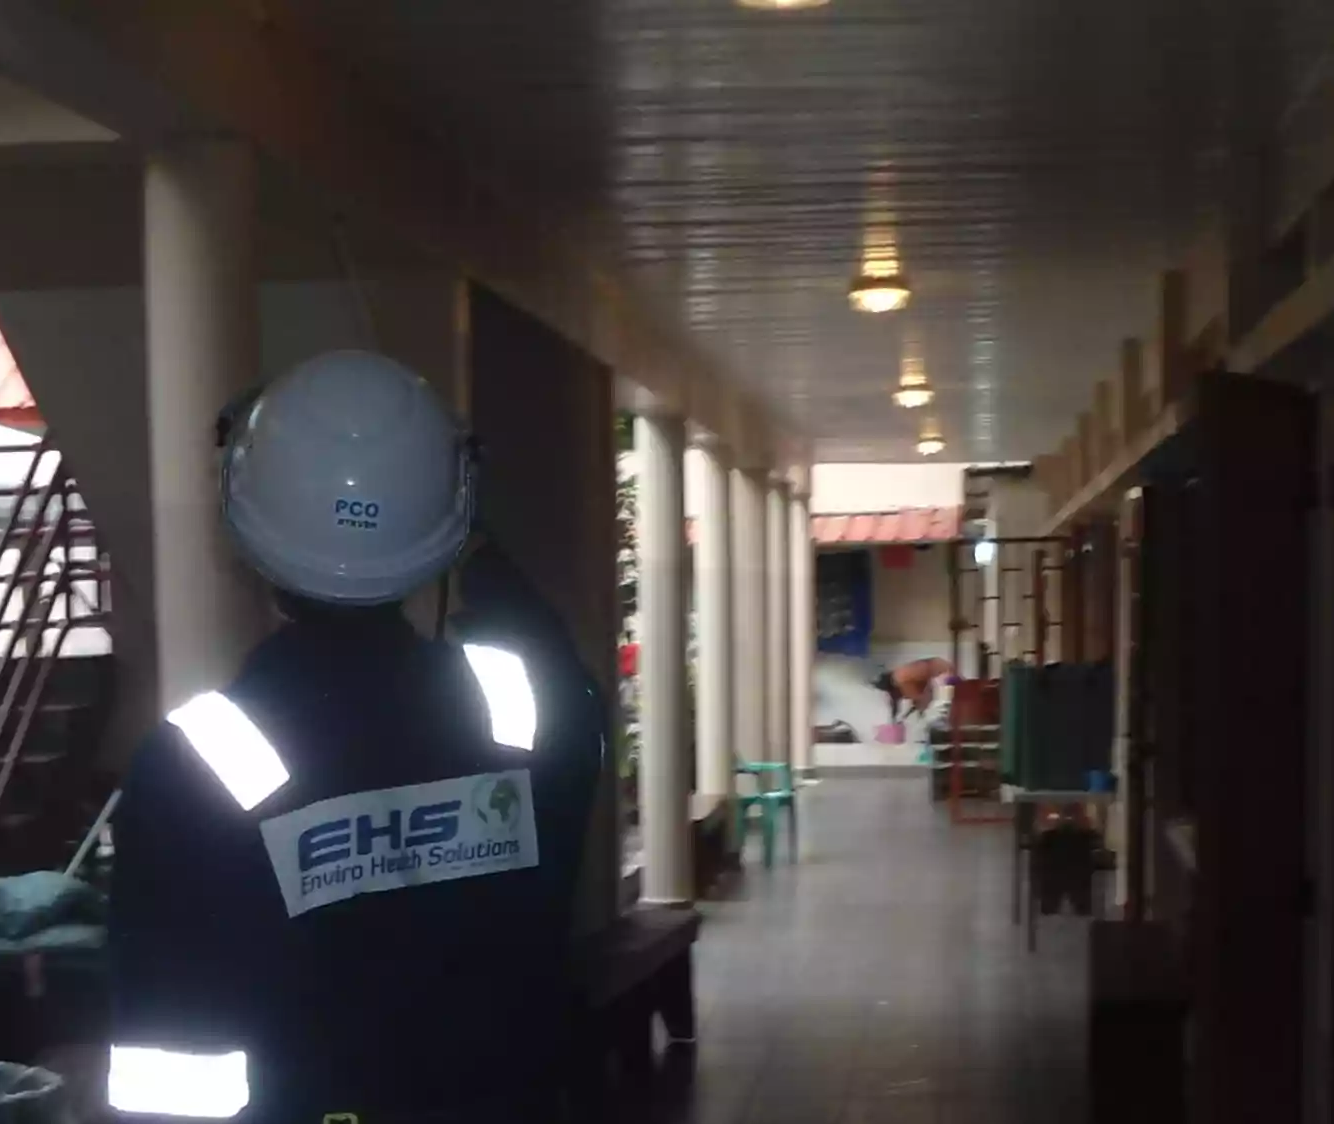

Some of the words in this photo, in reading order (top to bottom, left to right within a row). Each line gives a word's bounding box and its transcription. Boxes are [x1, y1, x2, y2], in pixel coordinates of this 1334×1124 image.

[335, 499, 379, 518] PCO
[298, 800, 462, 871] EHS
[300, 862, 364, 897] Enviro
[370, 849, 422, 877] Heth
[427, 838, 521, 867] Solutions
